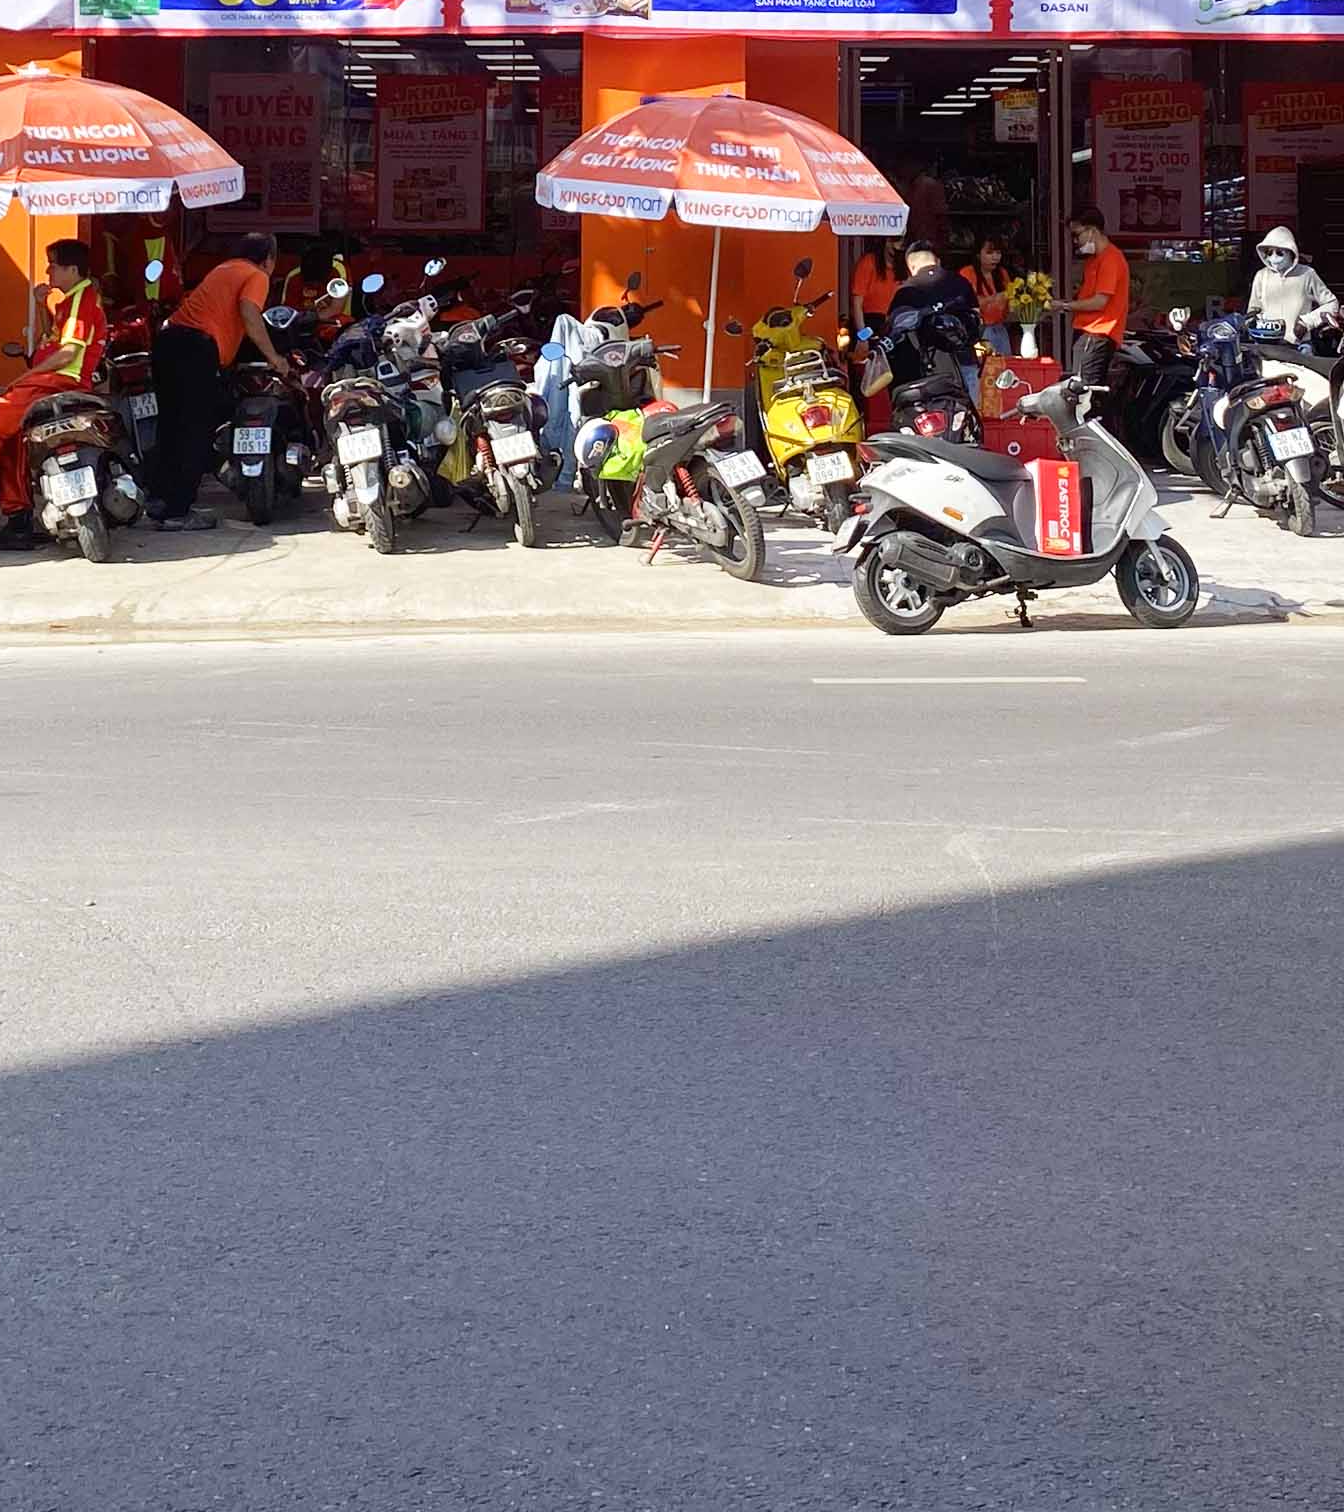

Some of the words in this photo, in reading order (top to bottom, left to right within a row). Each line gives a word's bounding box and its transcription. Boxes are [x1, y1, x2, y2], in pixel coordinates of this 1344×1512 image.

[1040, 2, 1089, 13] DASANI
[74, 122, 136, 139] NGON
[23, 145, 75, 165] CHẤT
[710, 141, 748, 158] SIÊU
